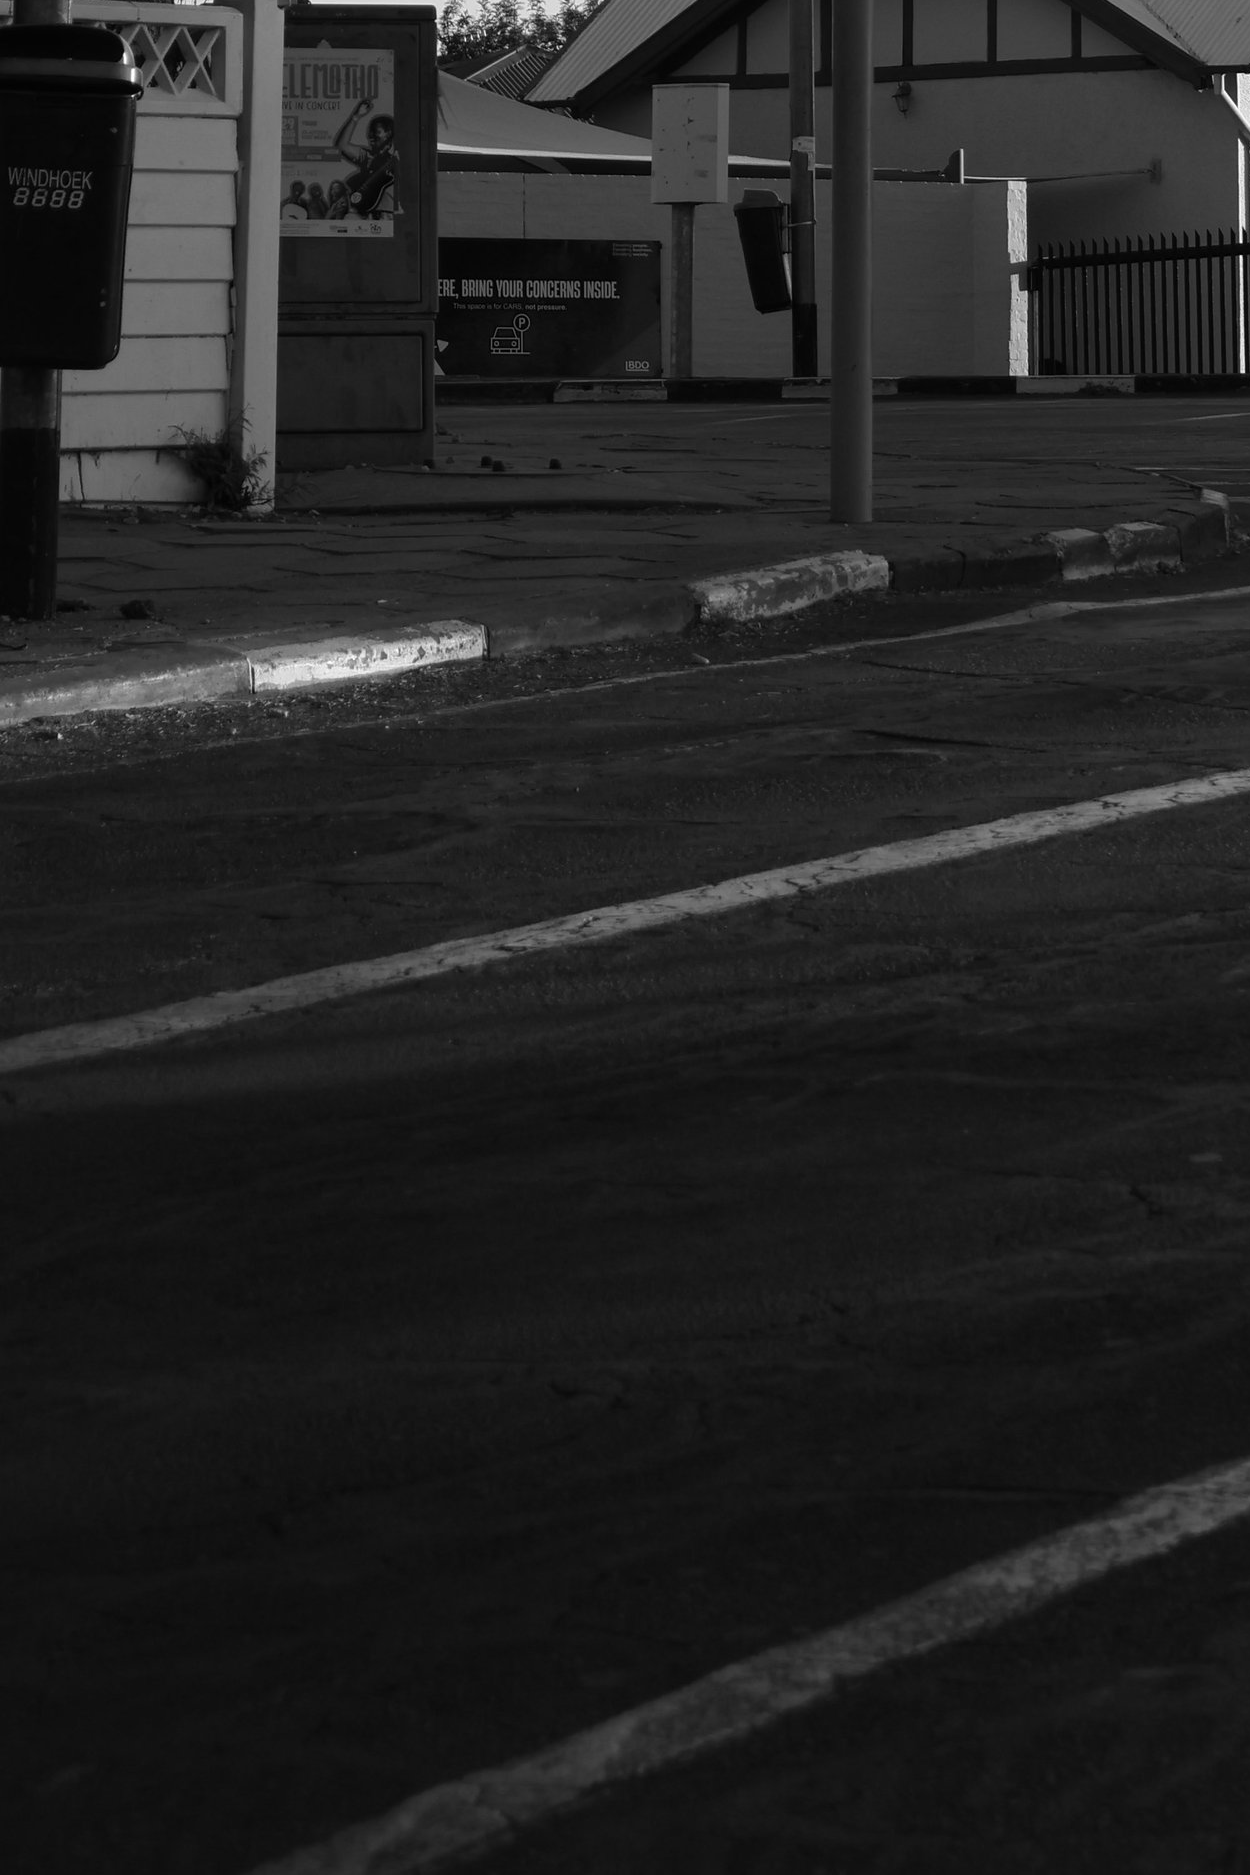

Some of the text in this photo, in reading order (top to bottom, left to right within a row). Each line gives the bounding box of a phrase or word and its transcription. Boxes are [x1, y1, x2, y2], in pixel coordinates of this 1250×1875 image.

[282, 101, 340, 110] IVE IN CONCERT
[8, 166, 93, 190] WINDHOEK
[12, 187, 85, 209] 8888
[438, 278, 620, 300] ERE, BRING YOUR CONCERNS INSIDE.
[467, 303, 486, 311] space
[525, 303, 536, 311] not
[537, 304, 567, 312] pressure.
[627, 358, 650, 369] BDO
